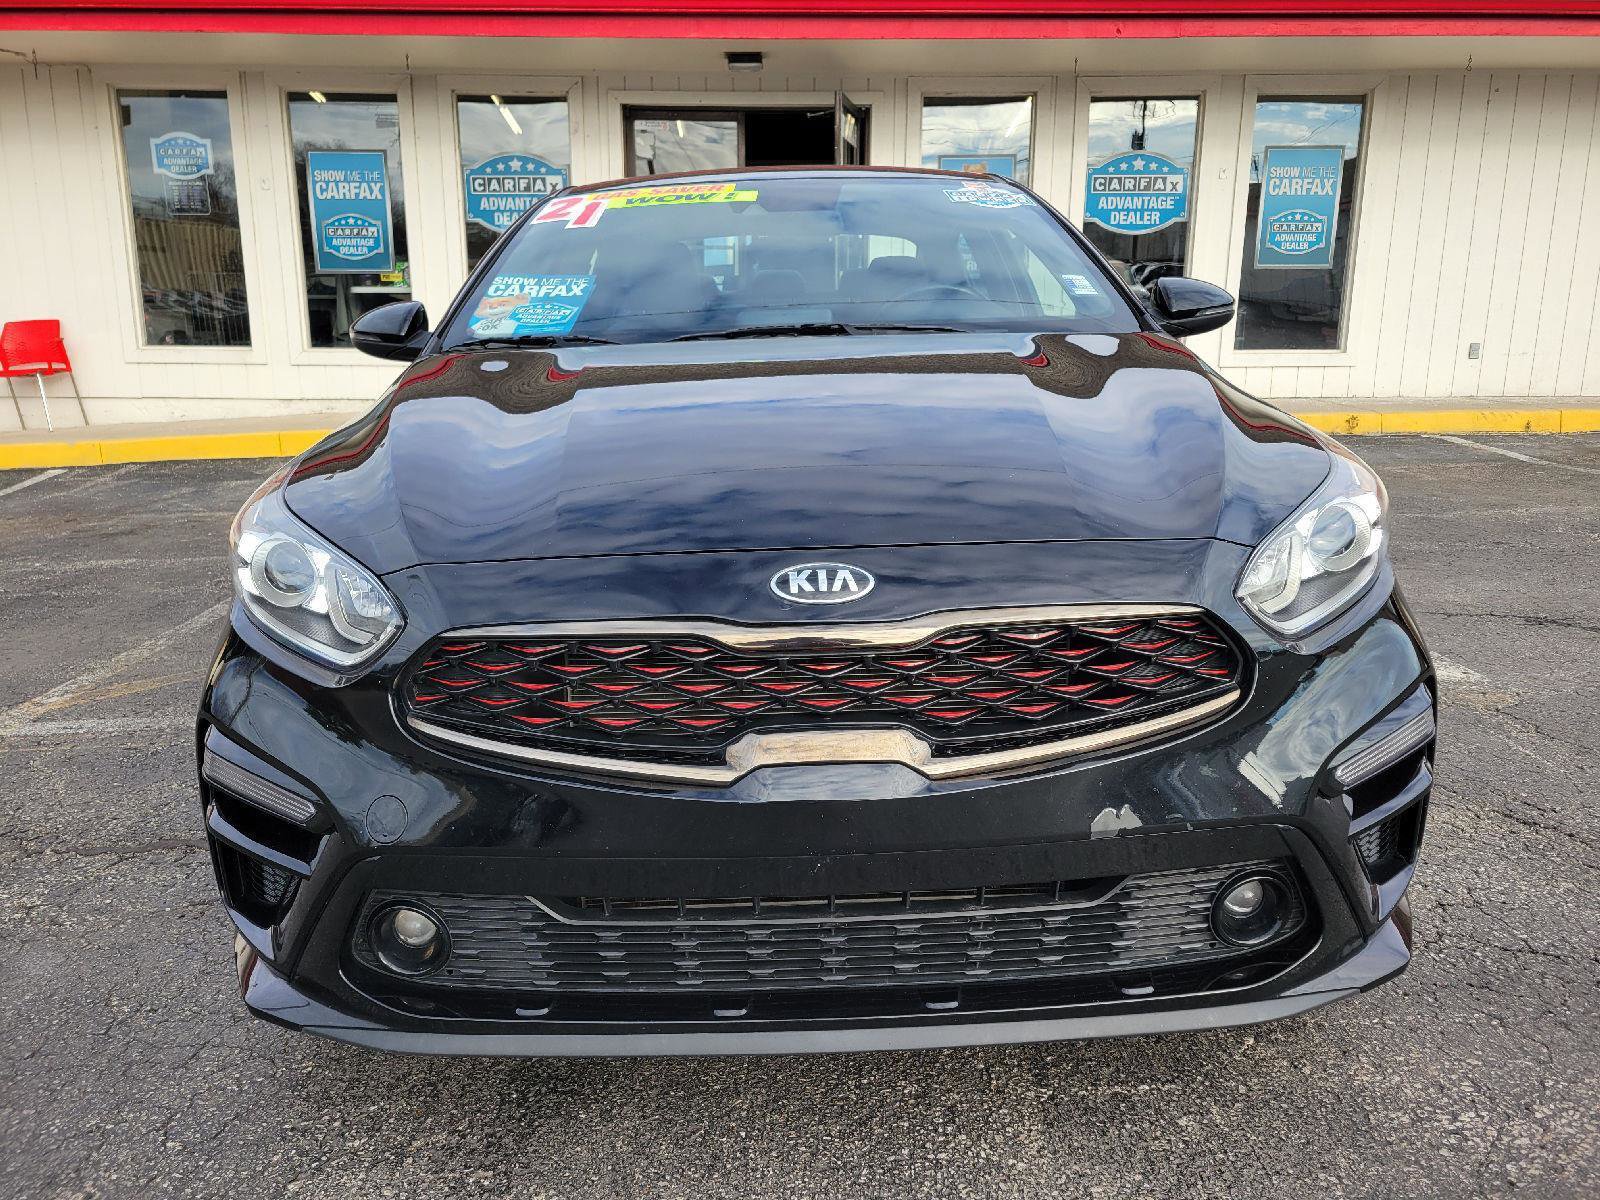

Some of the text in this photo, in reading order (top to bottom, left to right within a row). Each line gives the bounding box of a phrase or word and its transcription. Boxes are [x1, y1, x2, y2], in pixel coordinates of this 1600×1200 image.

[314, 170, 381, 181] SHOW ME THE
[1270, 166, 1336, 178] SHOW ME THE
[315, 181, 383, 200] CARFAX
[650, 184, 728, 194] SAVER
[1094, 178, 1181, 192] CARFAX
[1269, 178, 1334, 196] CARFAX
[480, 196, 538, 211] ADVANT
[1098, 196, 1175, 210] ADVANTAGE
[536, 197, 602, 226] 21
[1110, 211, 1161, 225] DEALER
[328, 228, 377, 237] CARFAX
[1273, 224, 1321, 232] CARFAX
[332, 238, 375, 246] ADVANTAGE
[1281, 241, 1309, 250] DEALER
[340, 246, 368, 255] DEALER
[492, 276, 590, 287] SHOW ME THE
[488, 285, 586, 297] CARFAX
[788, 569, 859, 593] KIA
